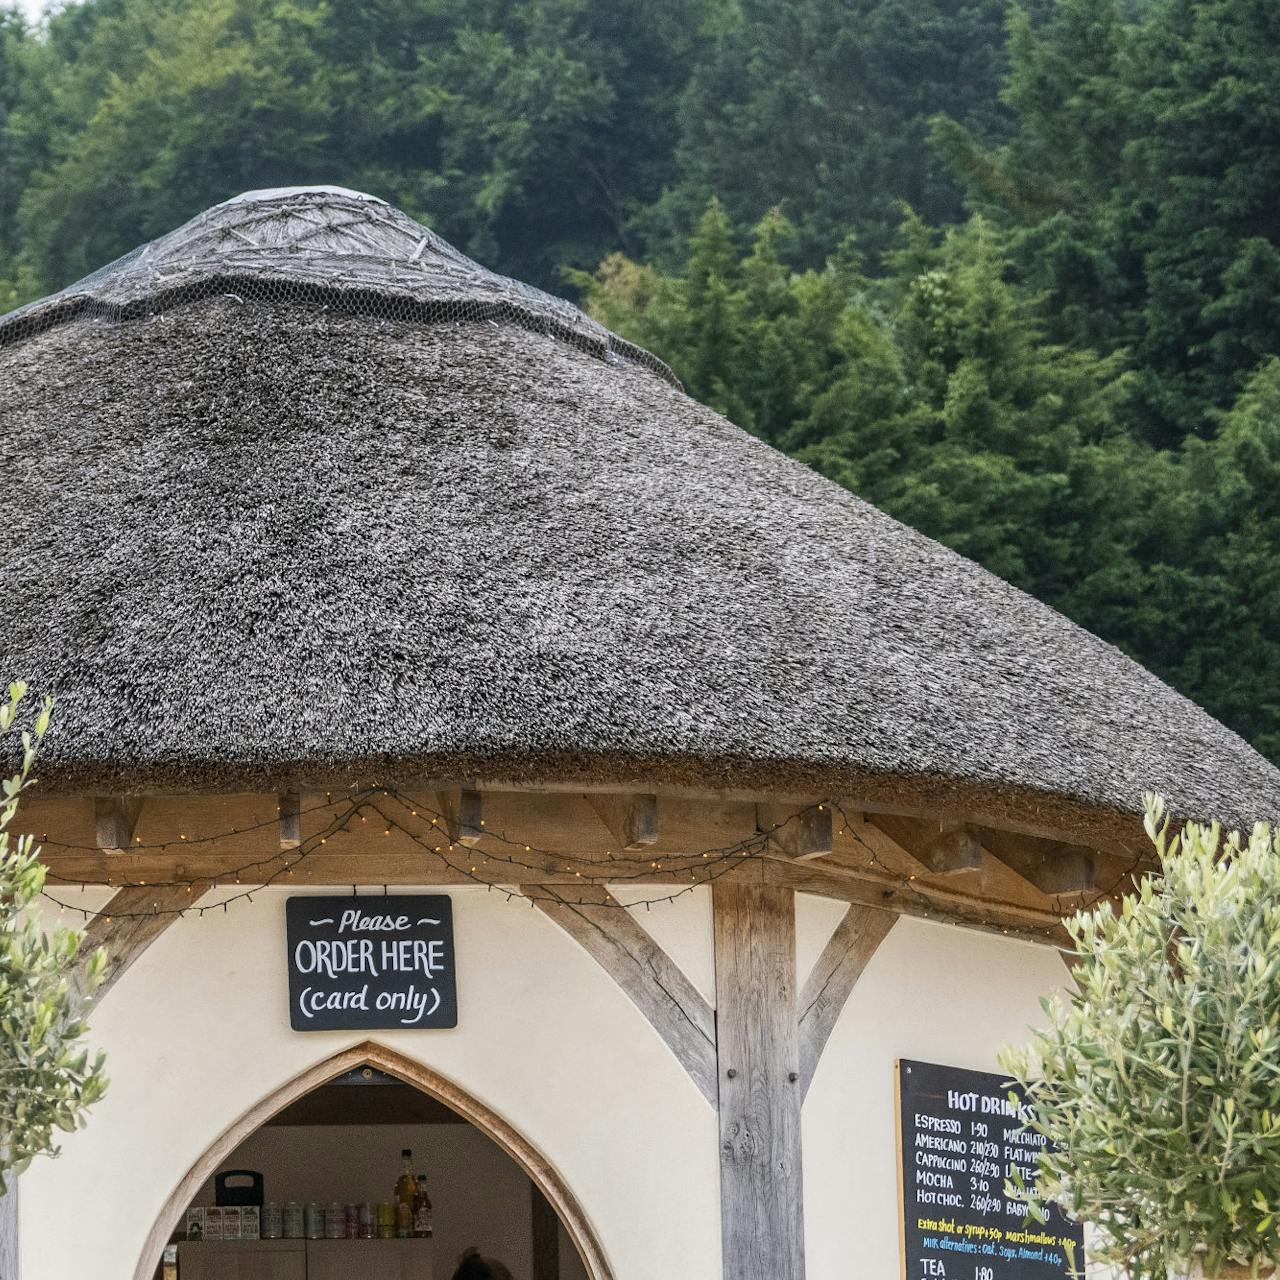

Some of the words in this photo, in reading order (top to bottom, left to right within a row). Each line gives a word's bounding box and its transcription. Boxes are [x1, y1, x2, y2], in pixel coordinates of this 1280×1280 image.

[338, 910, 411, 933] Please
[295, 939, 379, 979] ORDER
[381, 940, 445, 979] HERE
[299, 985, 369, 1018] (card
[376, 985, 441, 1023] only)
[947, 1090, 979, 1112] HOT
[914, 1113, 961, 1134] ESPRESSO
[915, 1132, 967, 1154] AMERICANO
[916, 1151, 967, 1172] CAPPUCCINO
[1005, 1146, 1024, 1162] FLAT
[916, 1169, 954, 1189] MOCHA
[1005, 1164, 1032, 1180] LTTE
[916, 1189, 936, 1204] HOT
[917, 1218, 937, 1231] Extra
[938, 1218, 955, 1234] shot
[956, 1225, 964, 1234] or
[920, 1259, 946, 1276] TEA
